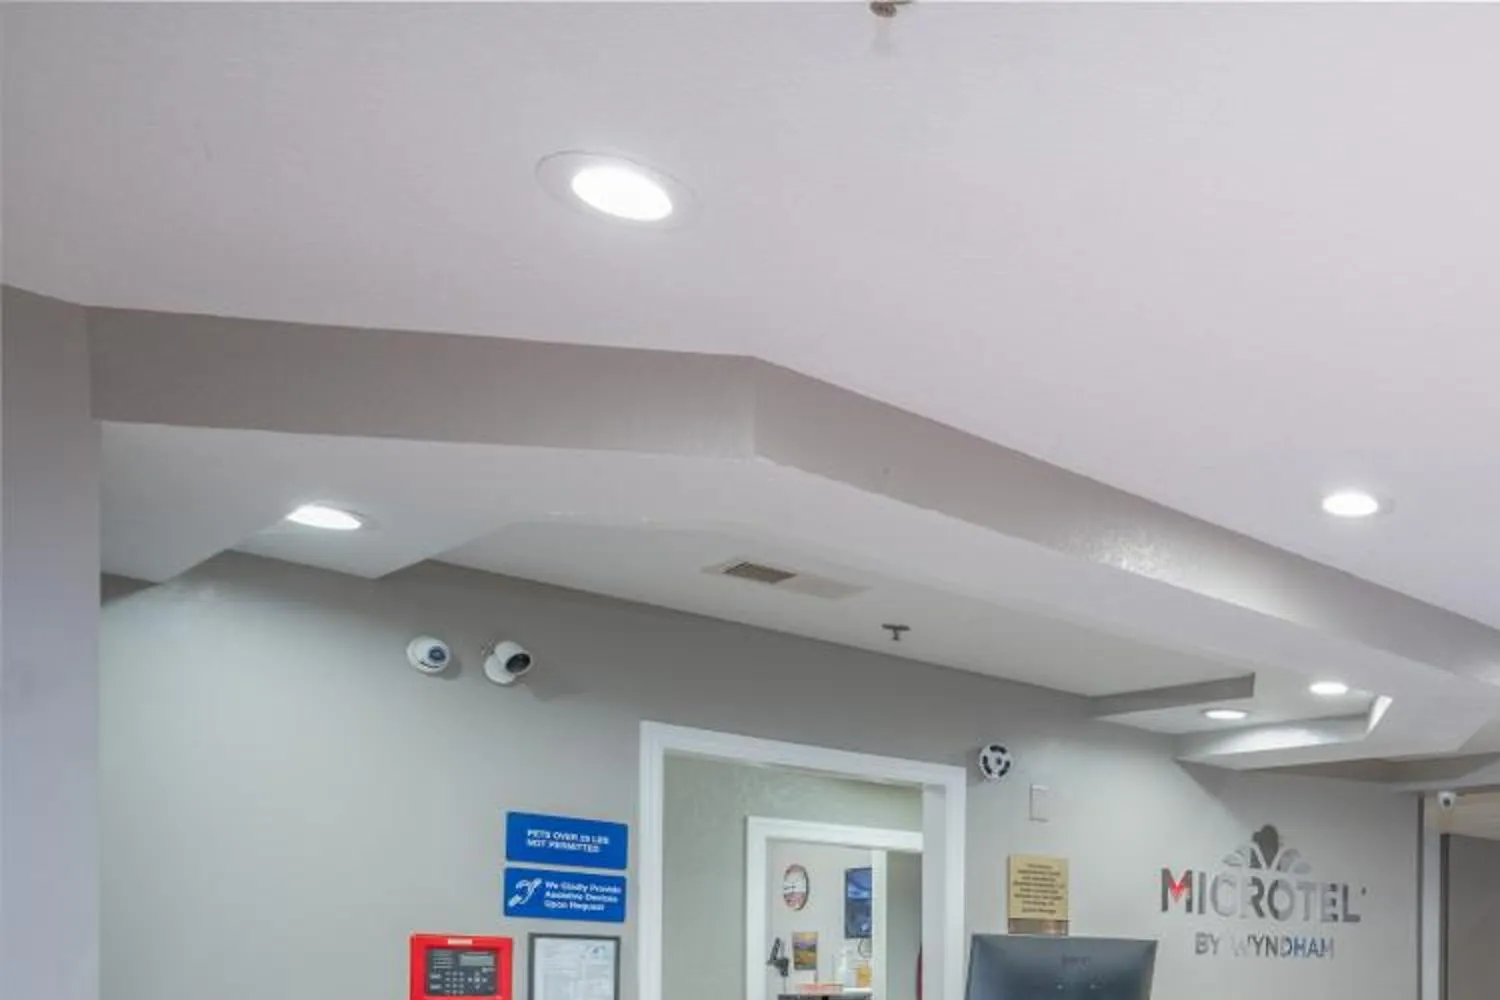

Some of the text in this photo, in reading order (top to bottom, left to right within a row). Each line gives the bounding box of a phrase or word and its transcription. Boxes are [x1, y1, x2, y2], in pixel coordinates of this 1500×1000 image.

[527, 830, 550, 839] PETS
[553, 832, 578, 841] OVER
[1161, 867, 1361, 923] MICROTEL
[1194, 932, 1335, 959] BY WYNDHAM
